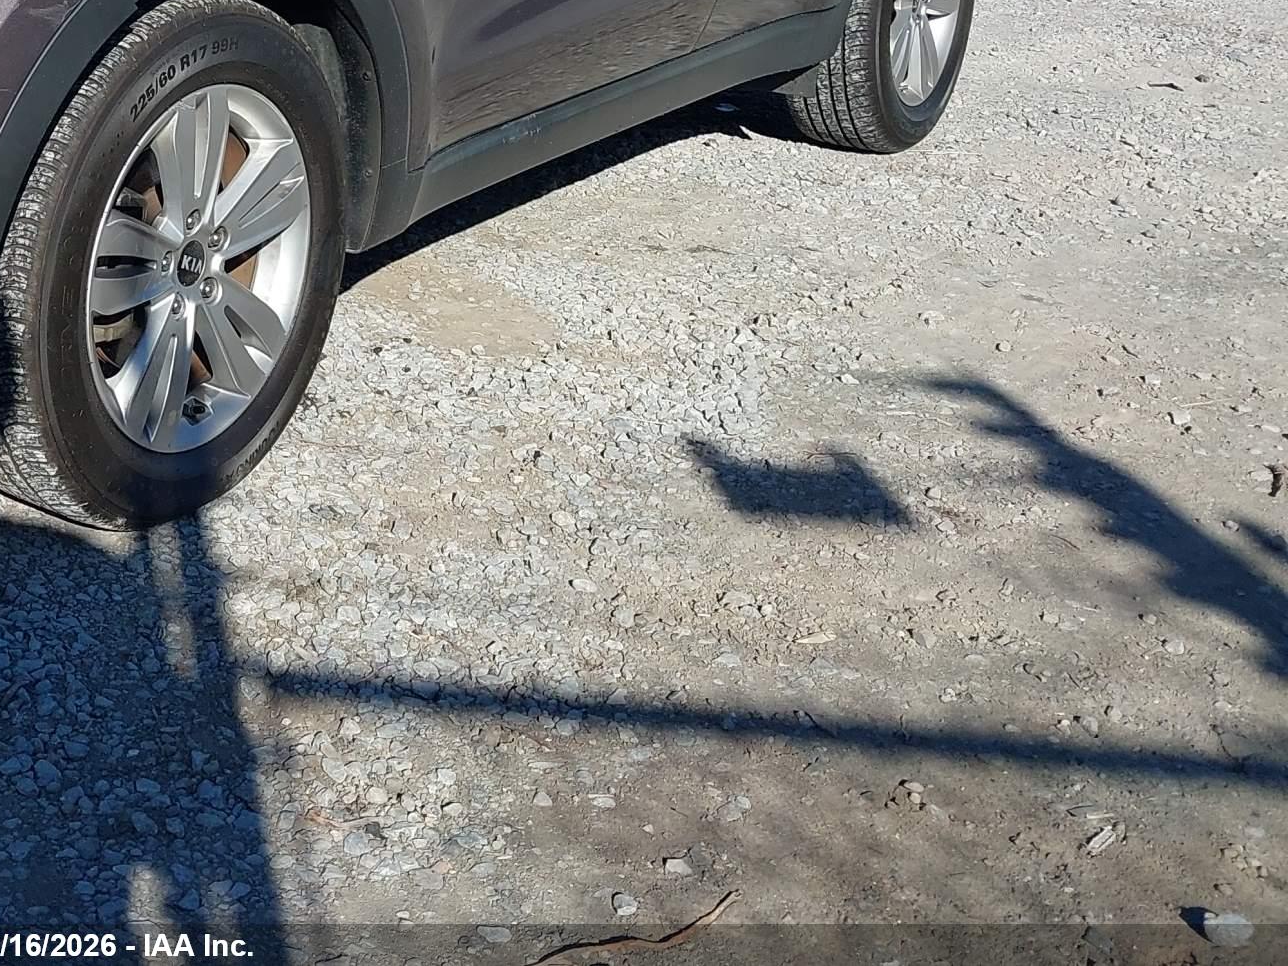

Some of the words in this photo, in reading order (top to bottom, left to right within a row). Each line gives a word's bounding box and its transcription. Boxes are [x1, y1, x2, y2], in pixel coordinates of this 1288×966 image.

[129, 64, 176, 123] 225/60
[180, 44, 208, 72] R17
[181, 254, 202, 275] KIA
